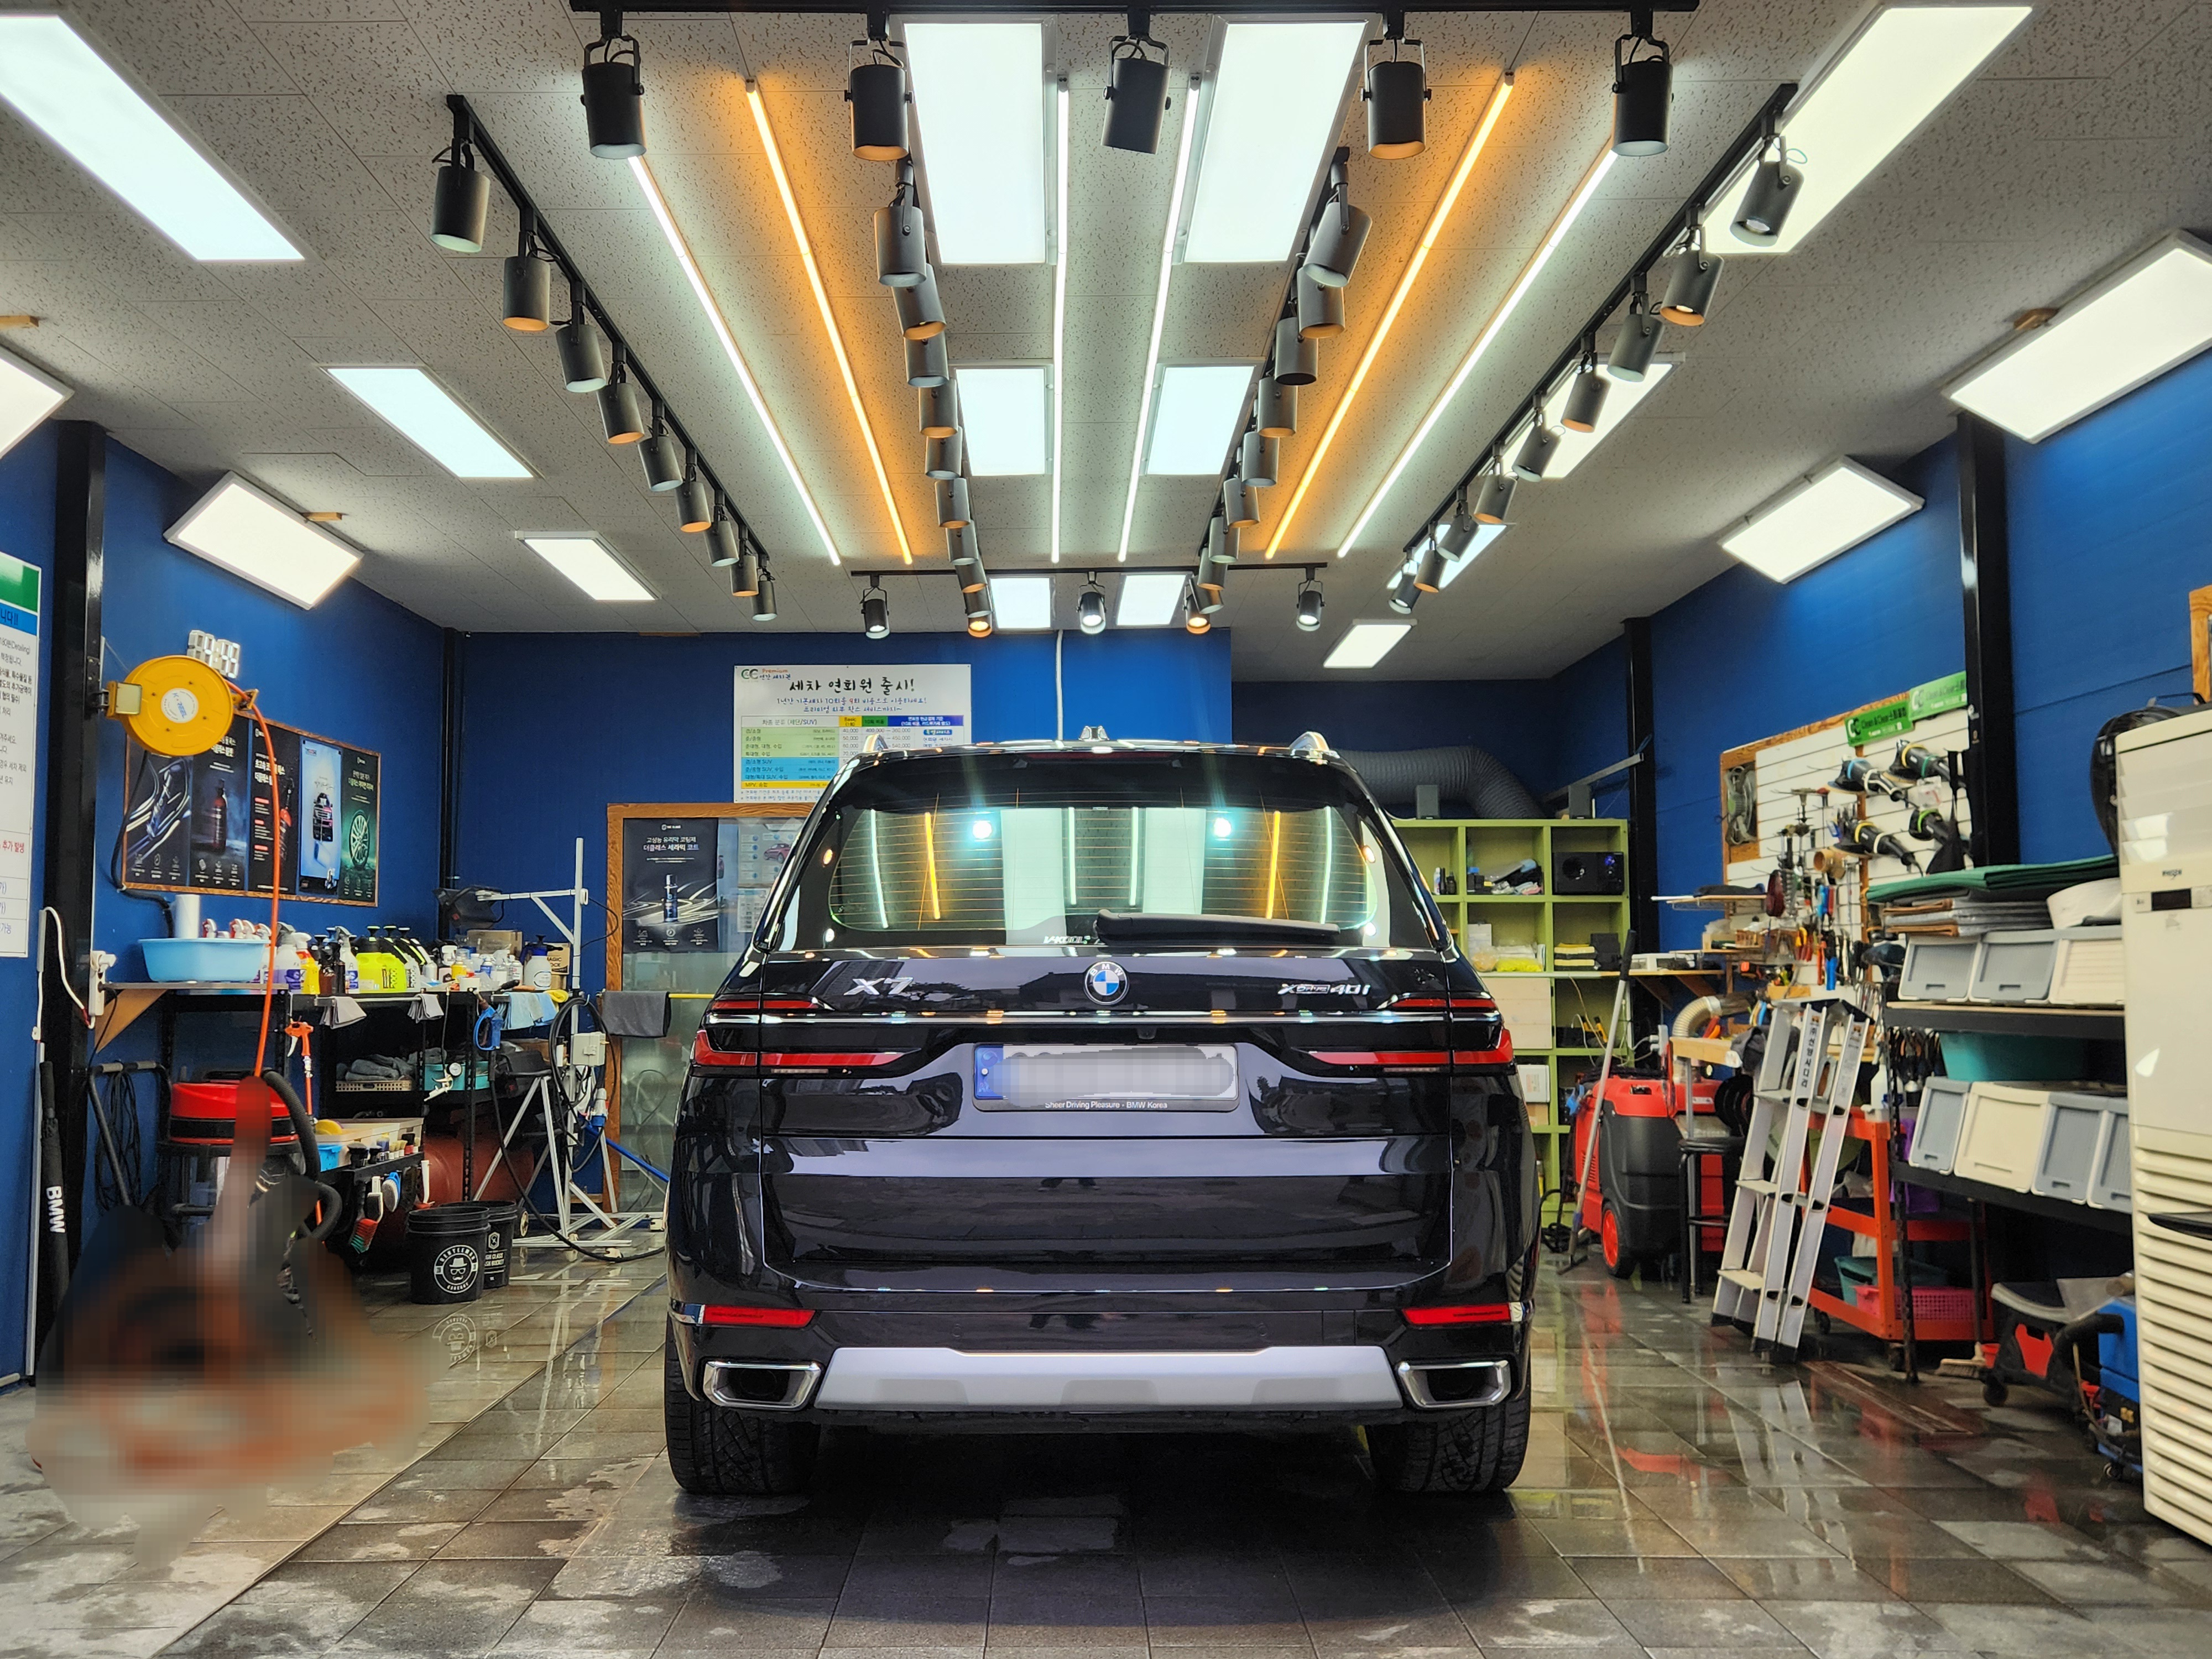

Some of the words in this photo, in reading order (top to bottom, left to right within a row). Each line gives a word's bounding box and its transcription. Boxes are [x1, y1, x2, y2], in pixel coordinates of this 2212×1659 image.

[789, 679, 822, 691] 세차
[828, 678, 872, 694] 연회원
[880, 676, 915, 696] 출시!
[825, 697, 846, 706] 10회를
[3, 840, 13, 852] 추가
[1089, 963, 1123, 977] BMW
[843, 977, 914, 995] X7
[1066, 1101, 1089, 1110] Driving
[1091, 1100, 1120, 1109] Pleasure
[1147, 1100, 1168, 1109] Korea
[46, 1185, 66, 1233] BMW
